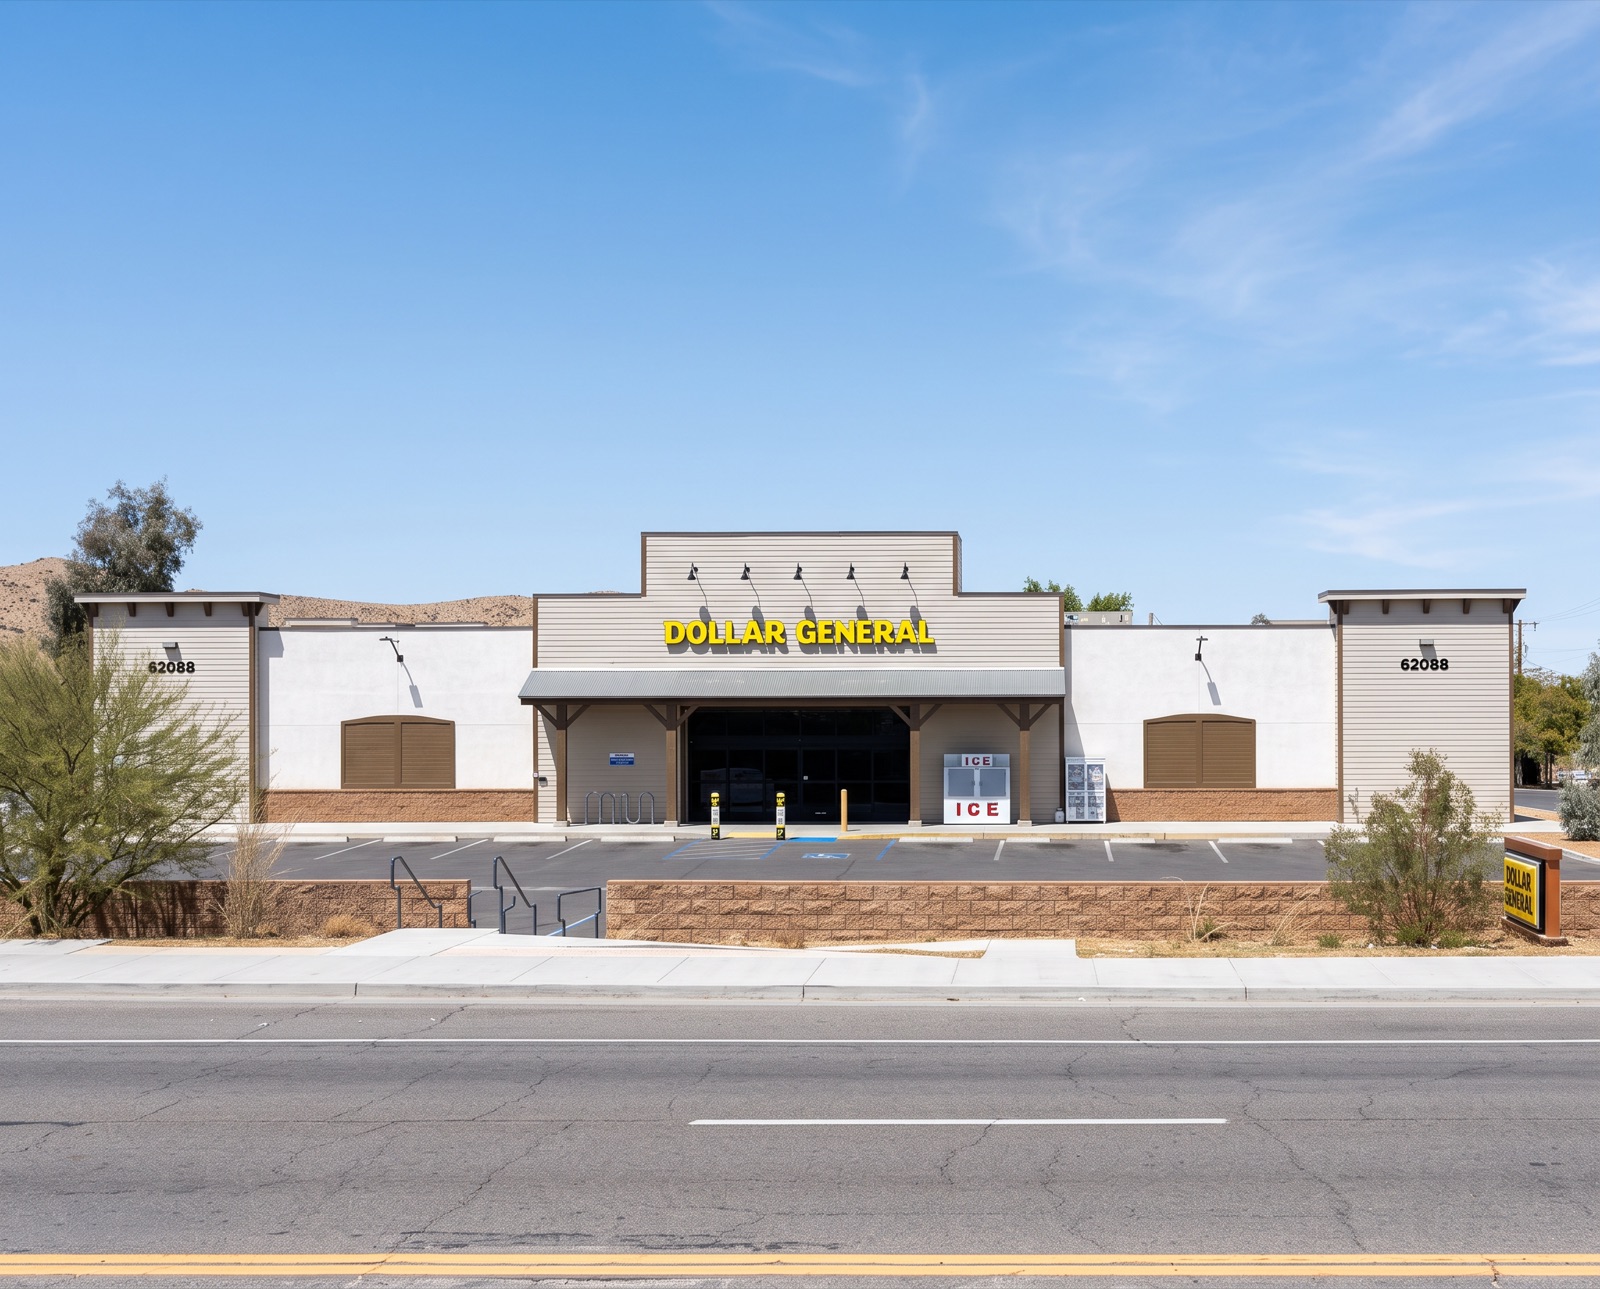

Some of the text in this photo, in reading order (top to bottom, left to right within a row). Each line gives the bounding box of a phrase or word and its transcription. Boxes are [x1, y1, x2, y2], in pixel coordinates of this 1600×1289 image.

[663, 620, 935, 645] DOLLAR GENERAL
[148, 661, 195, 674] 62088
[1400, 658, 1449, 671] 62088
[965, 756, 991, 766] ICE
[956, 802, 999, 816] ICE
[1506, 865, 1531, 893] DOLLAR
